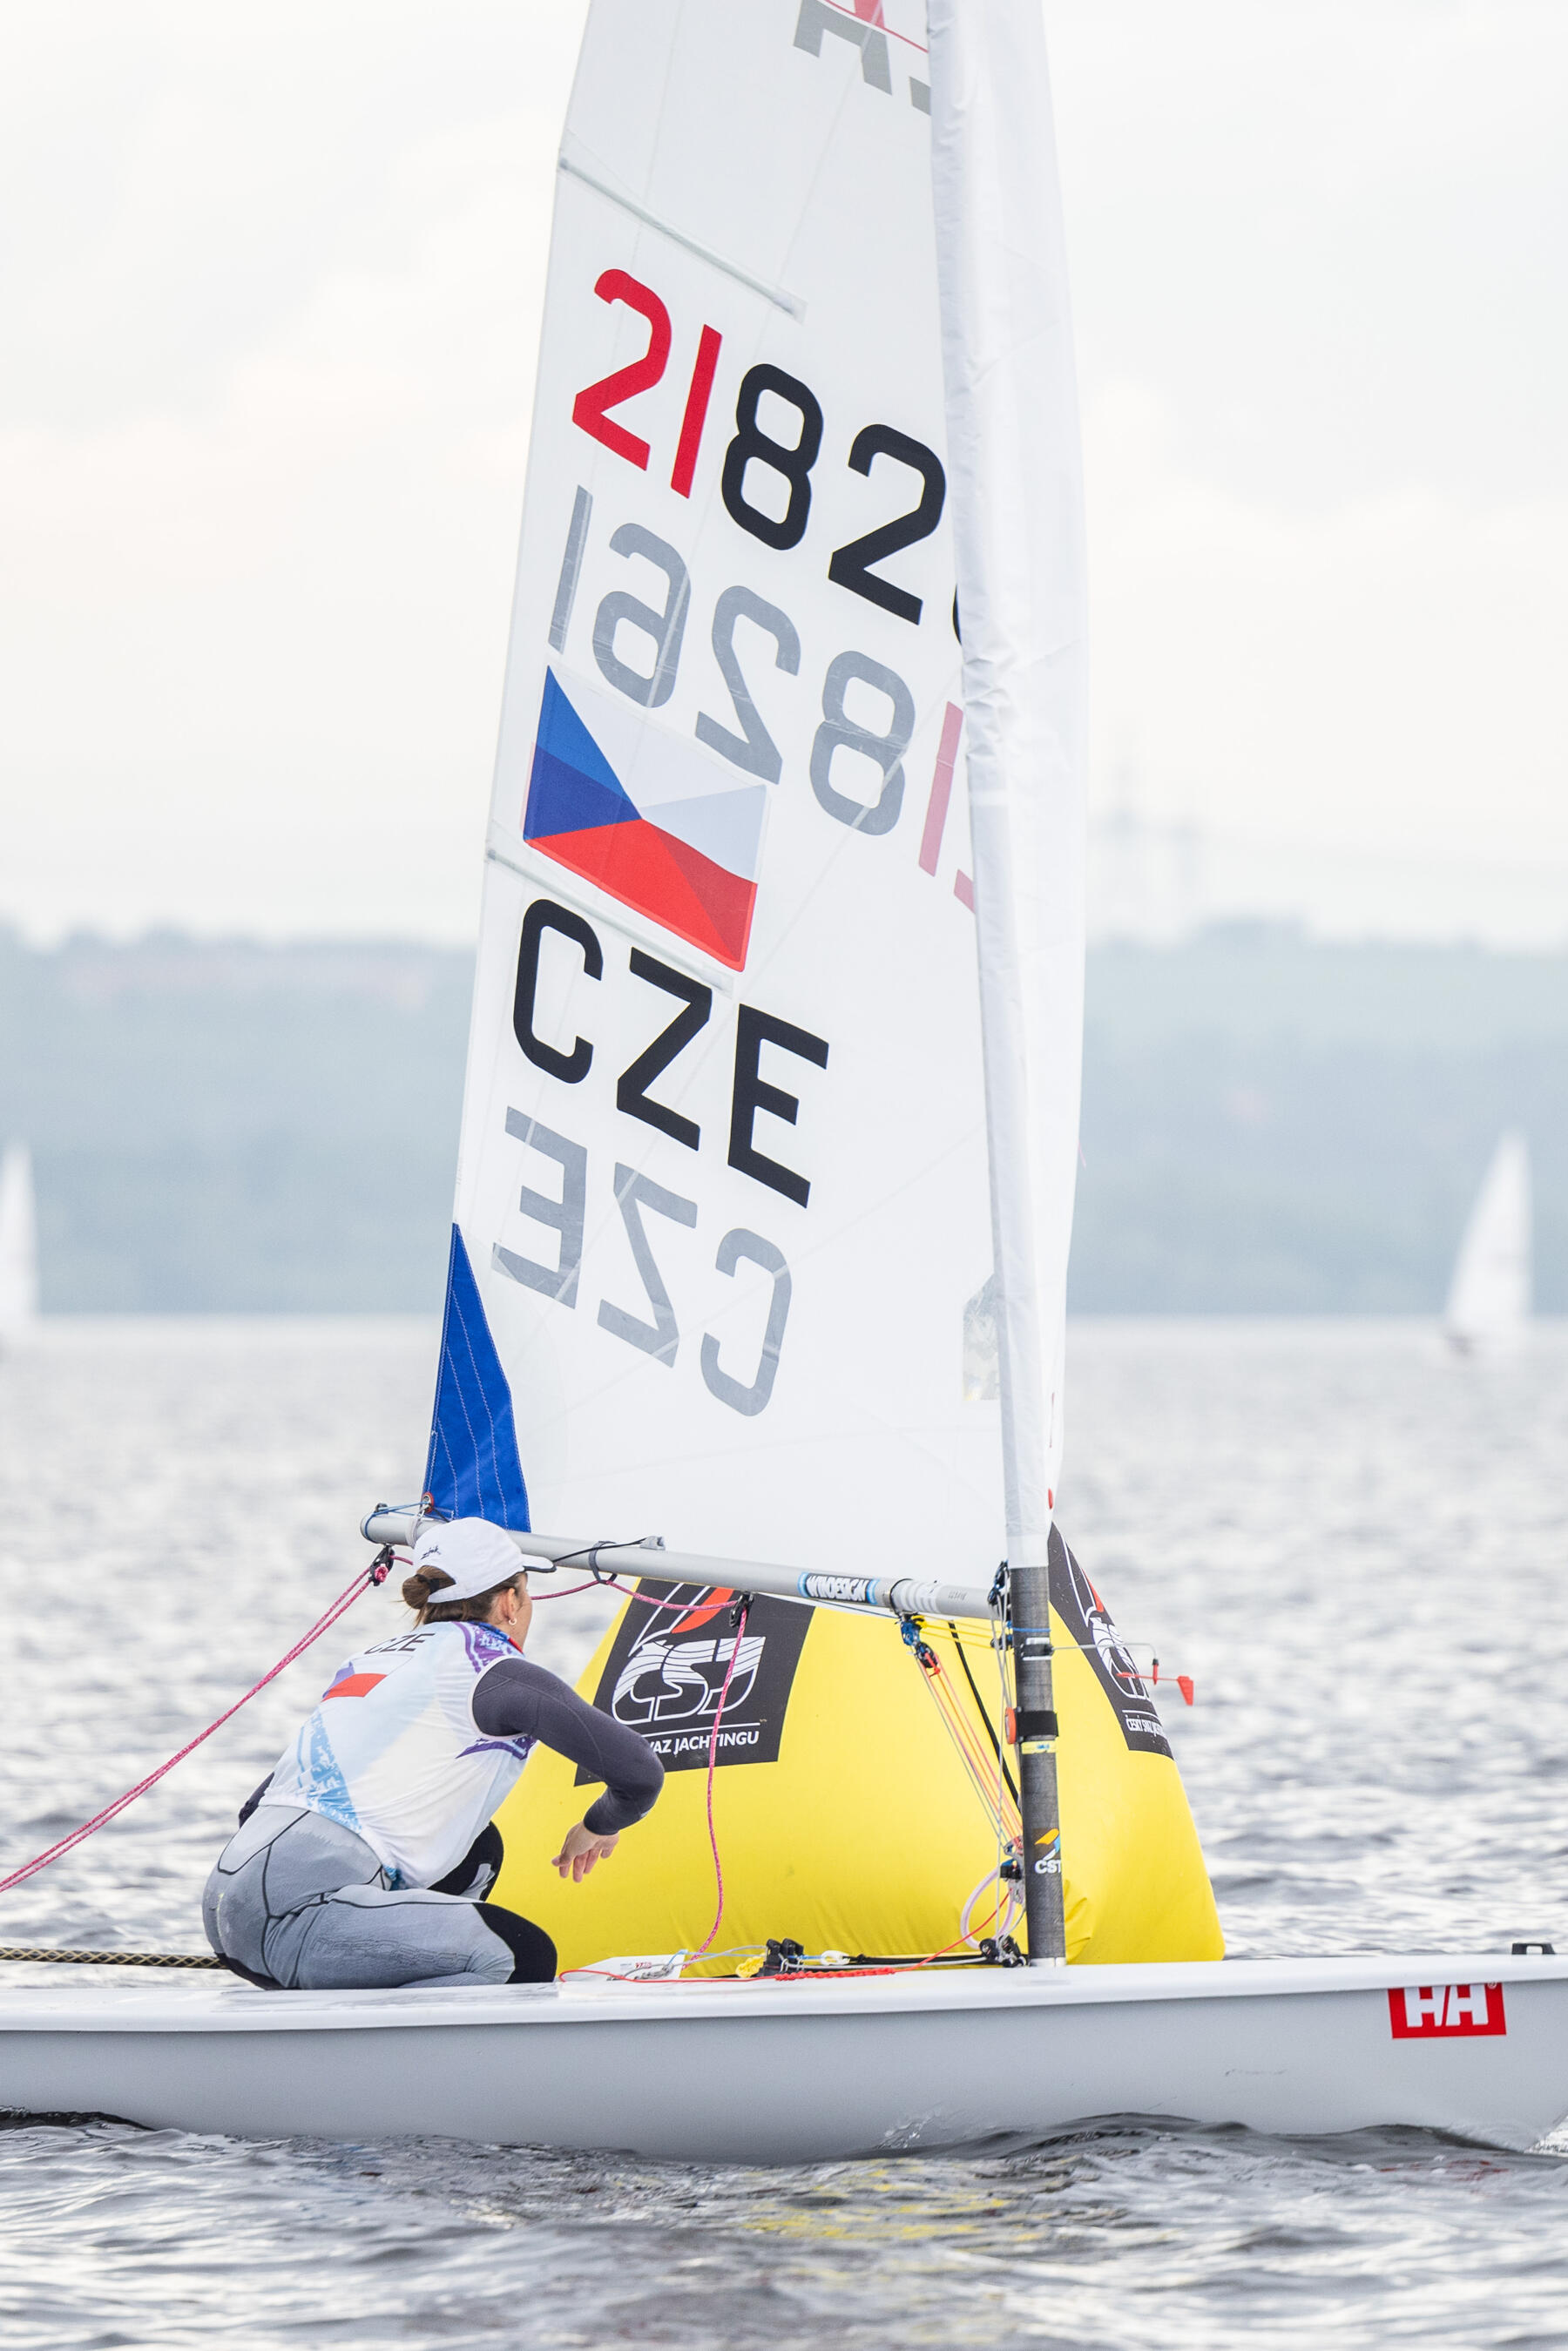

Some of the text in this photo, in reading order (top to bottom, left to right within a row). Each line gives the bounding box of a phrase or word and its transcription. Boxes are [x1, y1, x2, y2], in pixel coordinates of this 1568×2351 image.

[571, 268, 962, 646] 2182
[513, 899, 829, 1209] CZE
[806, 1575, 869, 1602] WINDESIGN
[364, 1633, 436, 1654] CZE
[673, 1730, 760, 1755] JACHTINGU
